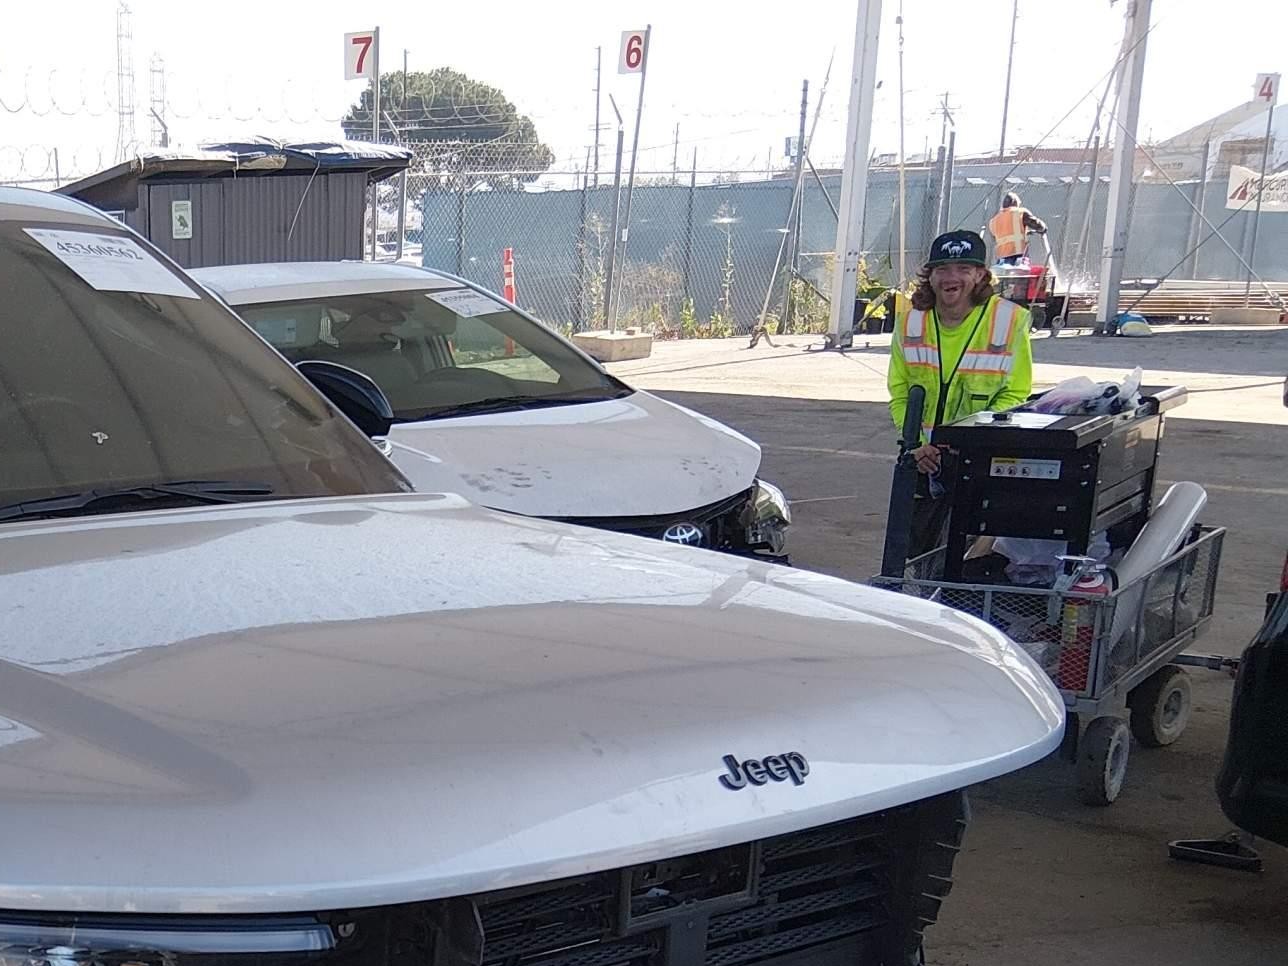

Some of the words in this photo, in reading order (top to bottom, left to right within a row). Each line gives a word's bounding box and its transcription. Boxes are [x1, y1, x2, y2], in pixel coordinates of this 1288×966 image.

[352, 36, 372, 73] 7
[626, 35, 642, 68] 6
[1259, 76, 1273, 102] 4
[718, 751, 810, 791] Jeep
